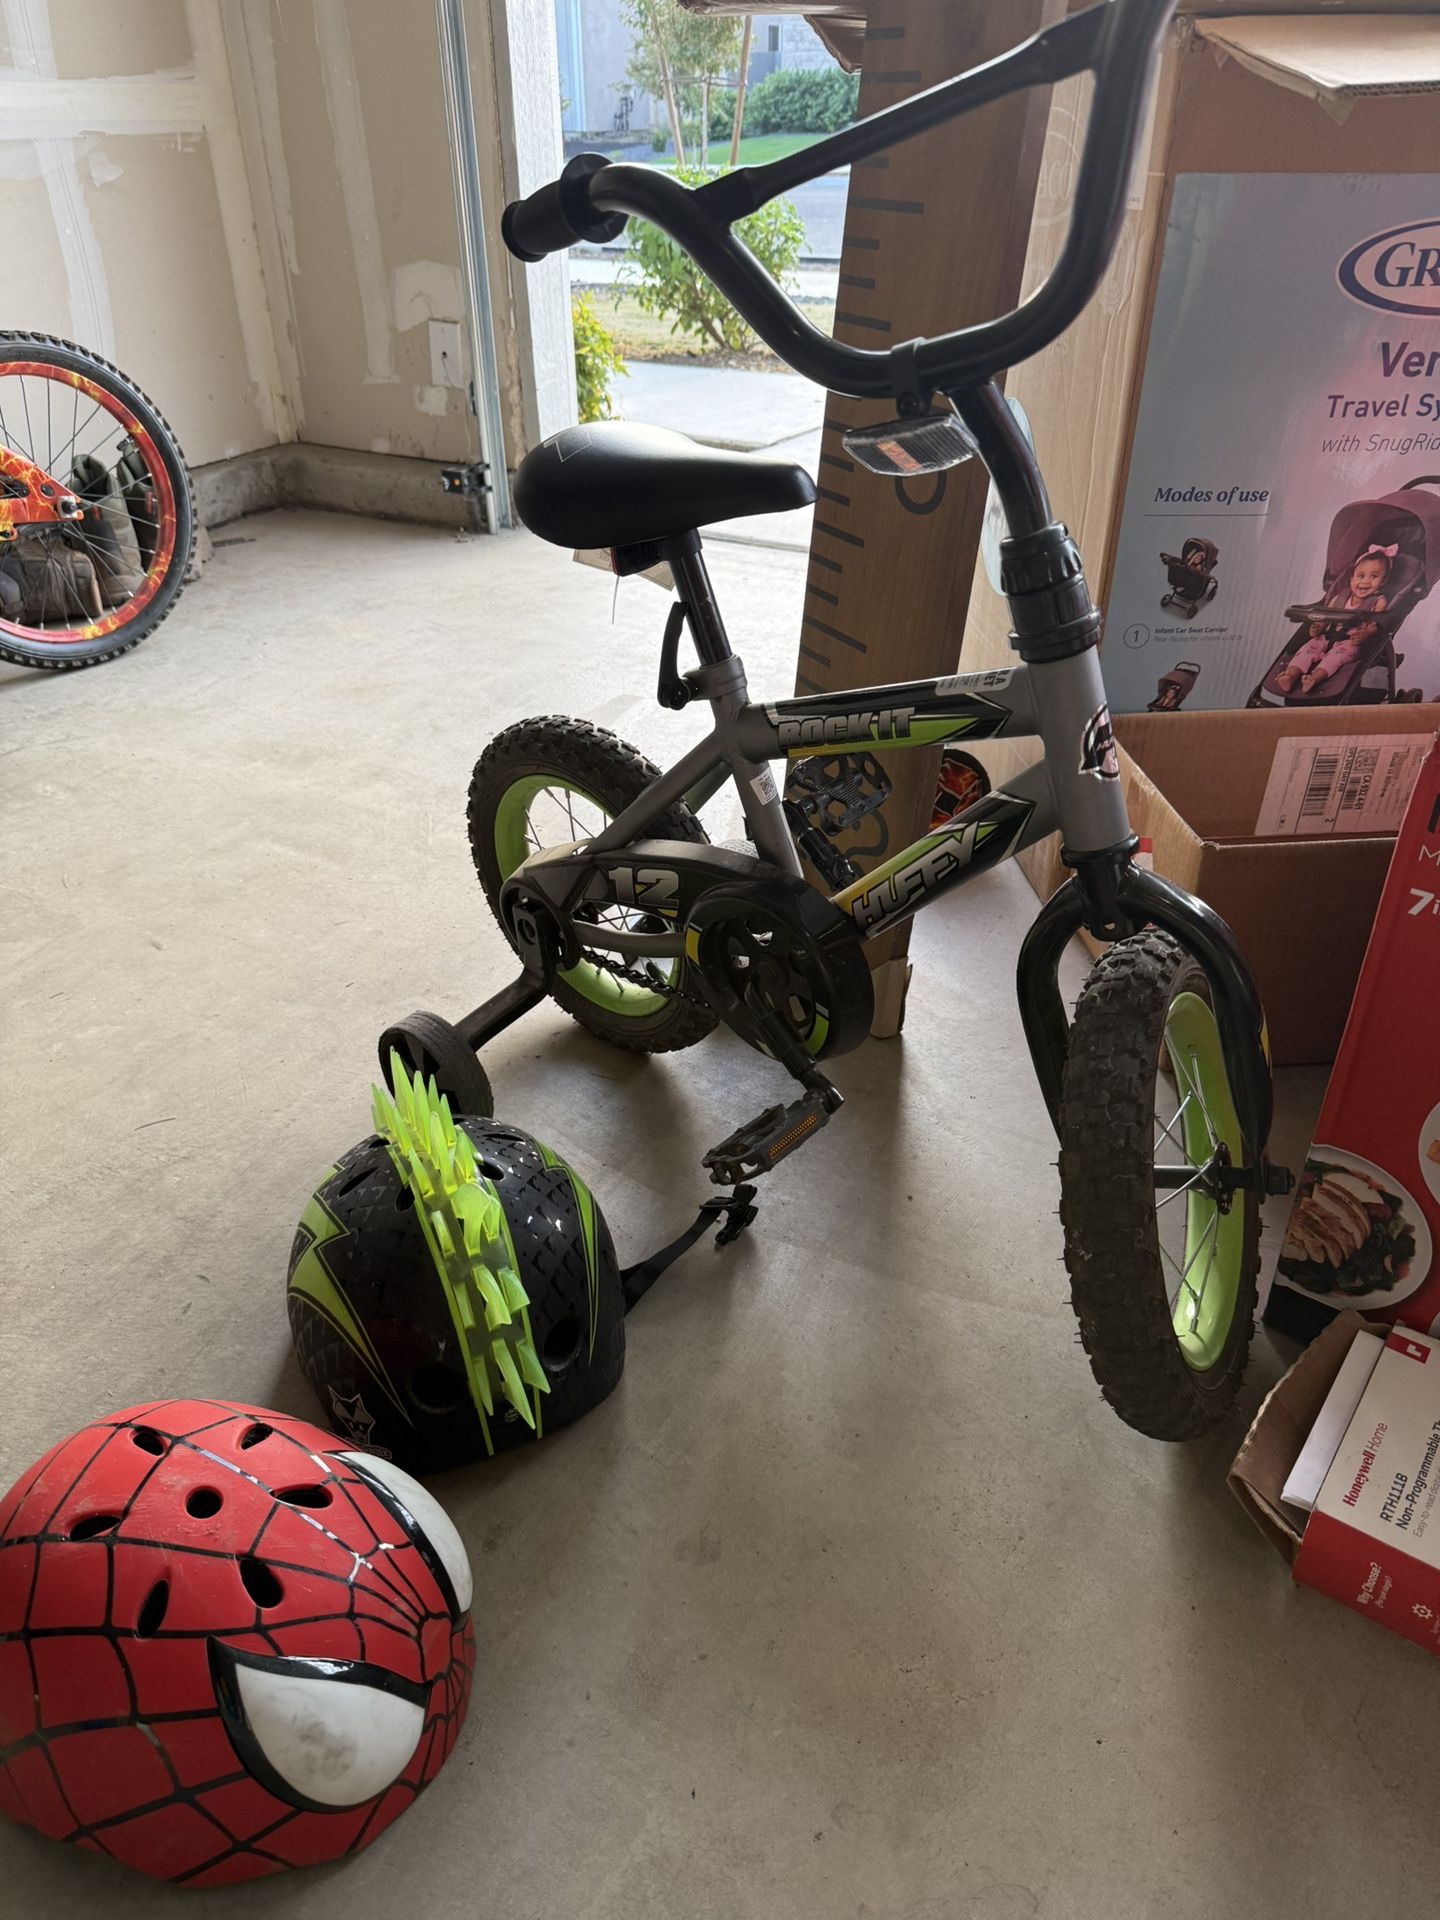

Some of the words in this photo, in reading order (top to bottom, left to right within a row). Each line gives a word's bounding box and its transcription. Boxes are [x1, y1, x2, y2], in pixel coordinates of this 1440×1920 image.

[1381, 341, 1440, 378] Ver
[1328, 394, 1410, 418] Travel
[1321, 434, 1361, 452] with
[1153, 486, 1213, 502] Modes
[1216, 486, 1239, 506] of
[1239, 490, 1269, 502] use
[1188, 626, 1203, 634] Seat
[1204, 626, 1228, 634] Carrier
[778, 712, 875, 749] ROCK
[877, 706, 916, 740] IT
[608, 867, 680, 908] 12
[851, 820, 978, 932] HUFFY
[1343, 1449, 1376, 1507] Honeywell
[1365, 1422, 1388, 1452] Home
[1395, 1433, 1440, 1530] Non-Programmable
[1379, 1472, 1408, 1522] RTH111B
